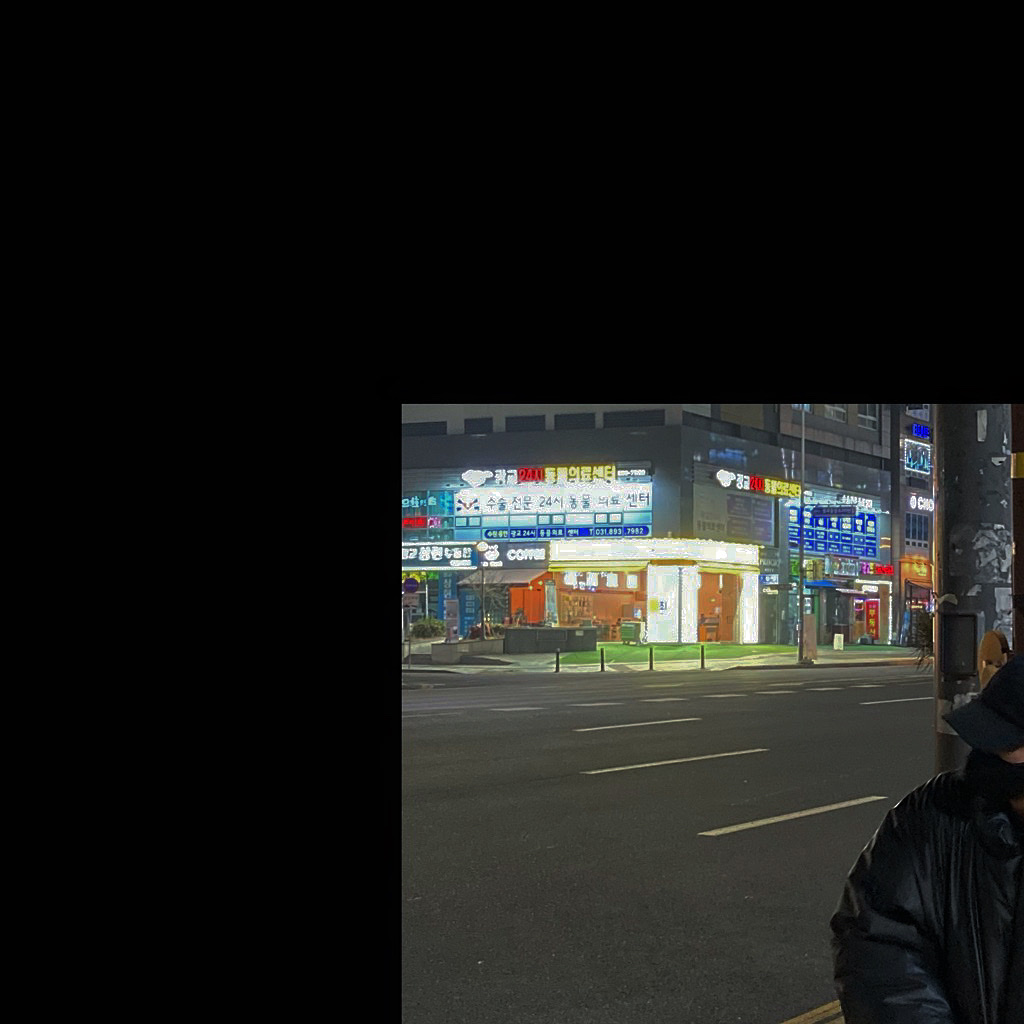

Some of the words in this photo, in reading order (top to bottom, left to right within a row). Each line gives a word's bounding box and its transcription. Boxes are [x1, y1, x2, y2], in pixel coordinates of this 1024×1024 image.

[486, 496, 507, 510] 수술
[511, 496, 532, 510] 전문
[539, 495, 564, 508] 24시
[626, 492, 650, 507] 센터
